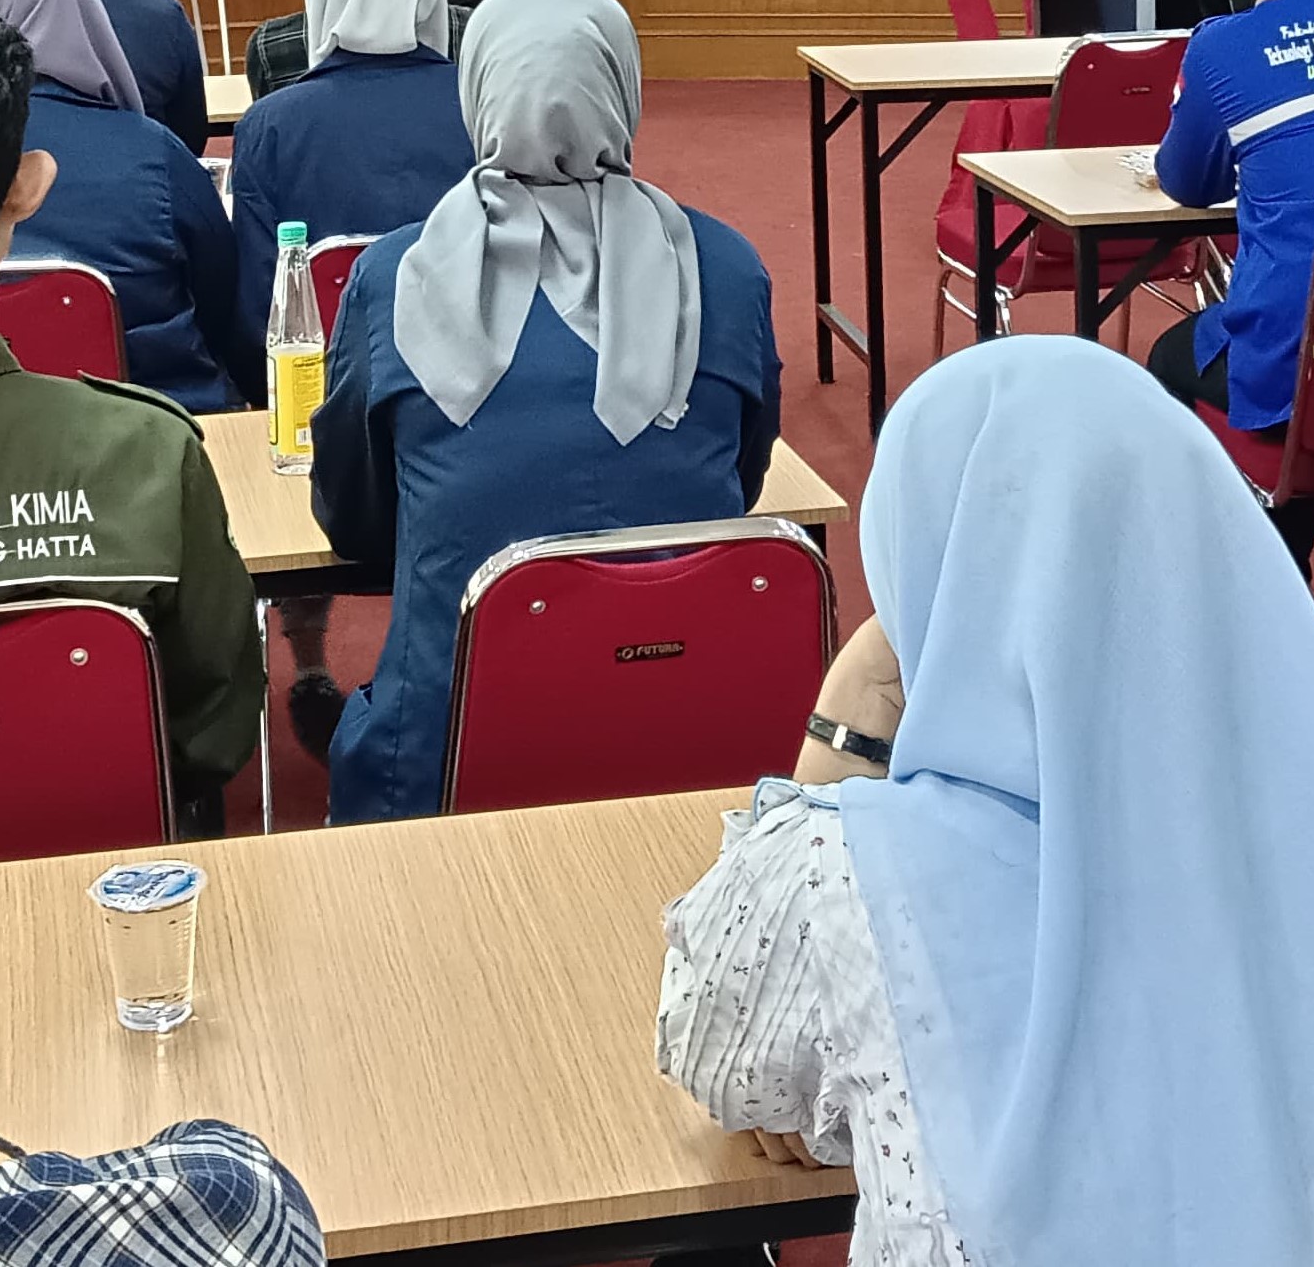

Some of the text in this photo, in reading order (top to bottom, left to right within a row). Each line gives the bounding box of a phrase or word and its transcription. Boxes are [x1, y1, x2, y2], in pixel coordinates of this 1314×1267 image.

[1264, 39, 1313, 66] Teknologi
[10, 489, 95, 528] KIMIA
[17, 534, 96, 561] HATTA
